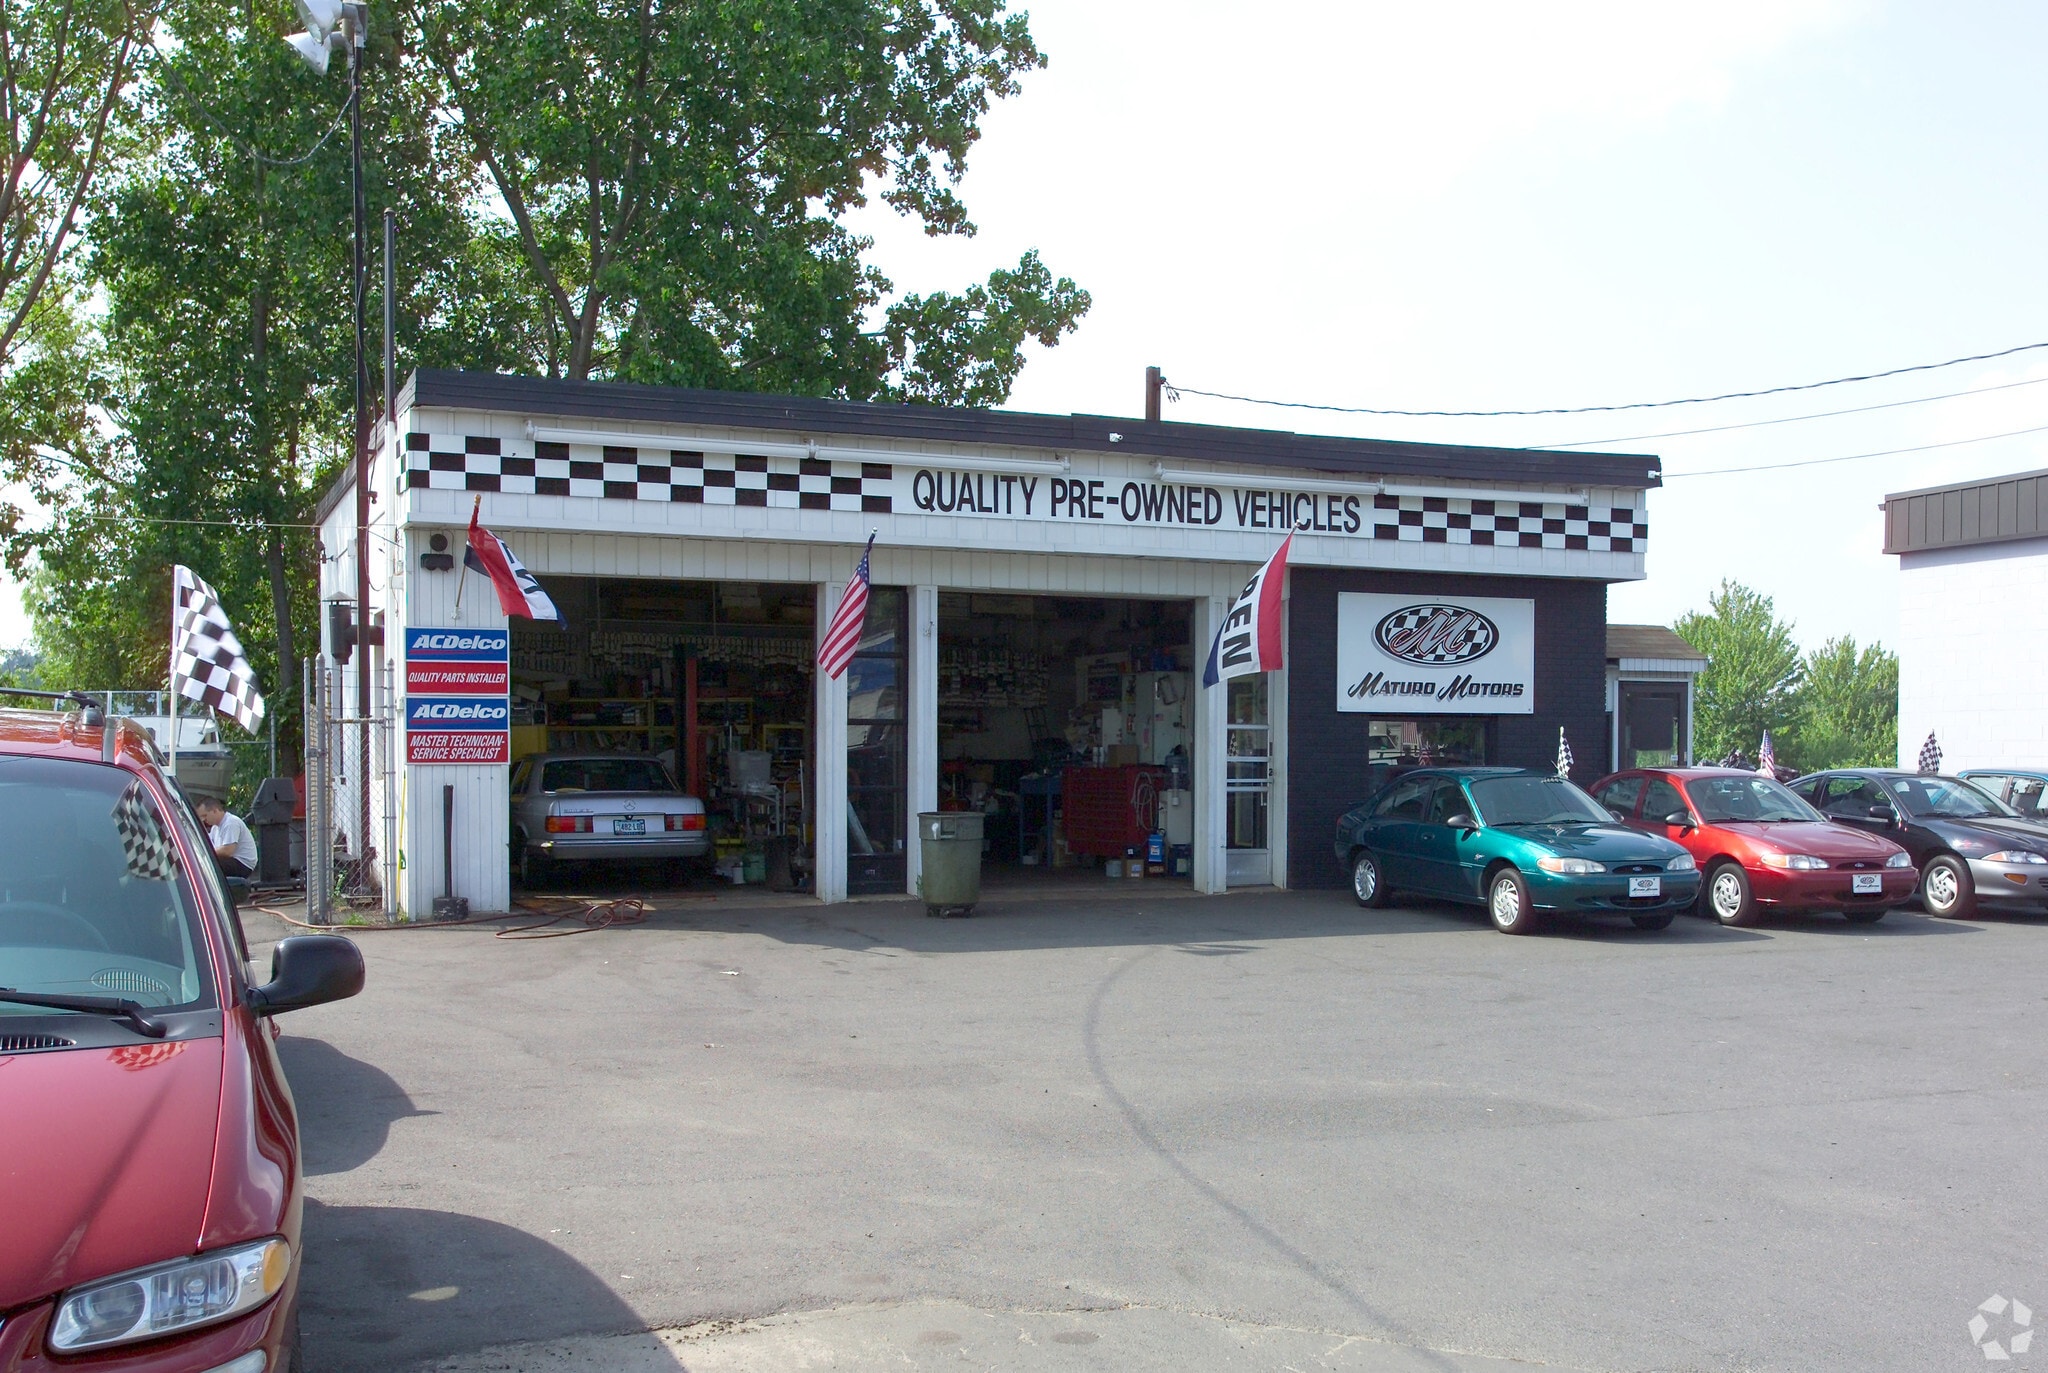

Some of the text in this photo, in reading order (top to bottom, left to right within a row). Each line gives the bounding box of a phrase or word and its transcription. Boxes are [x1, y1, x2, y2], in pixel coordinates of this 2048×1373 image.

[913, 469, 1361, 534] QUALITY PRE-OWNED VEHICLES
[1222, 574, 1261, 669] PEN
[412, 634, 506, 650] ACDelco
[408, 671, 506, 684] QUALITY PARTS INSTALLER
[412, 704, 507, 719] ACDelco
[410, 735, 449, 747] MASTER
[411, 747, 501, 760] SERVICE SPECIALIST
